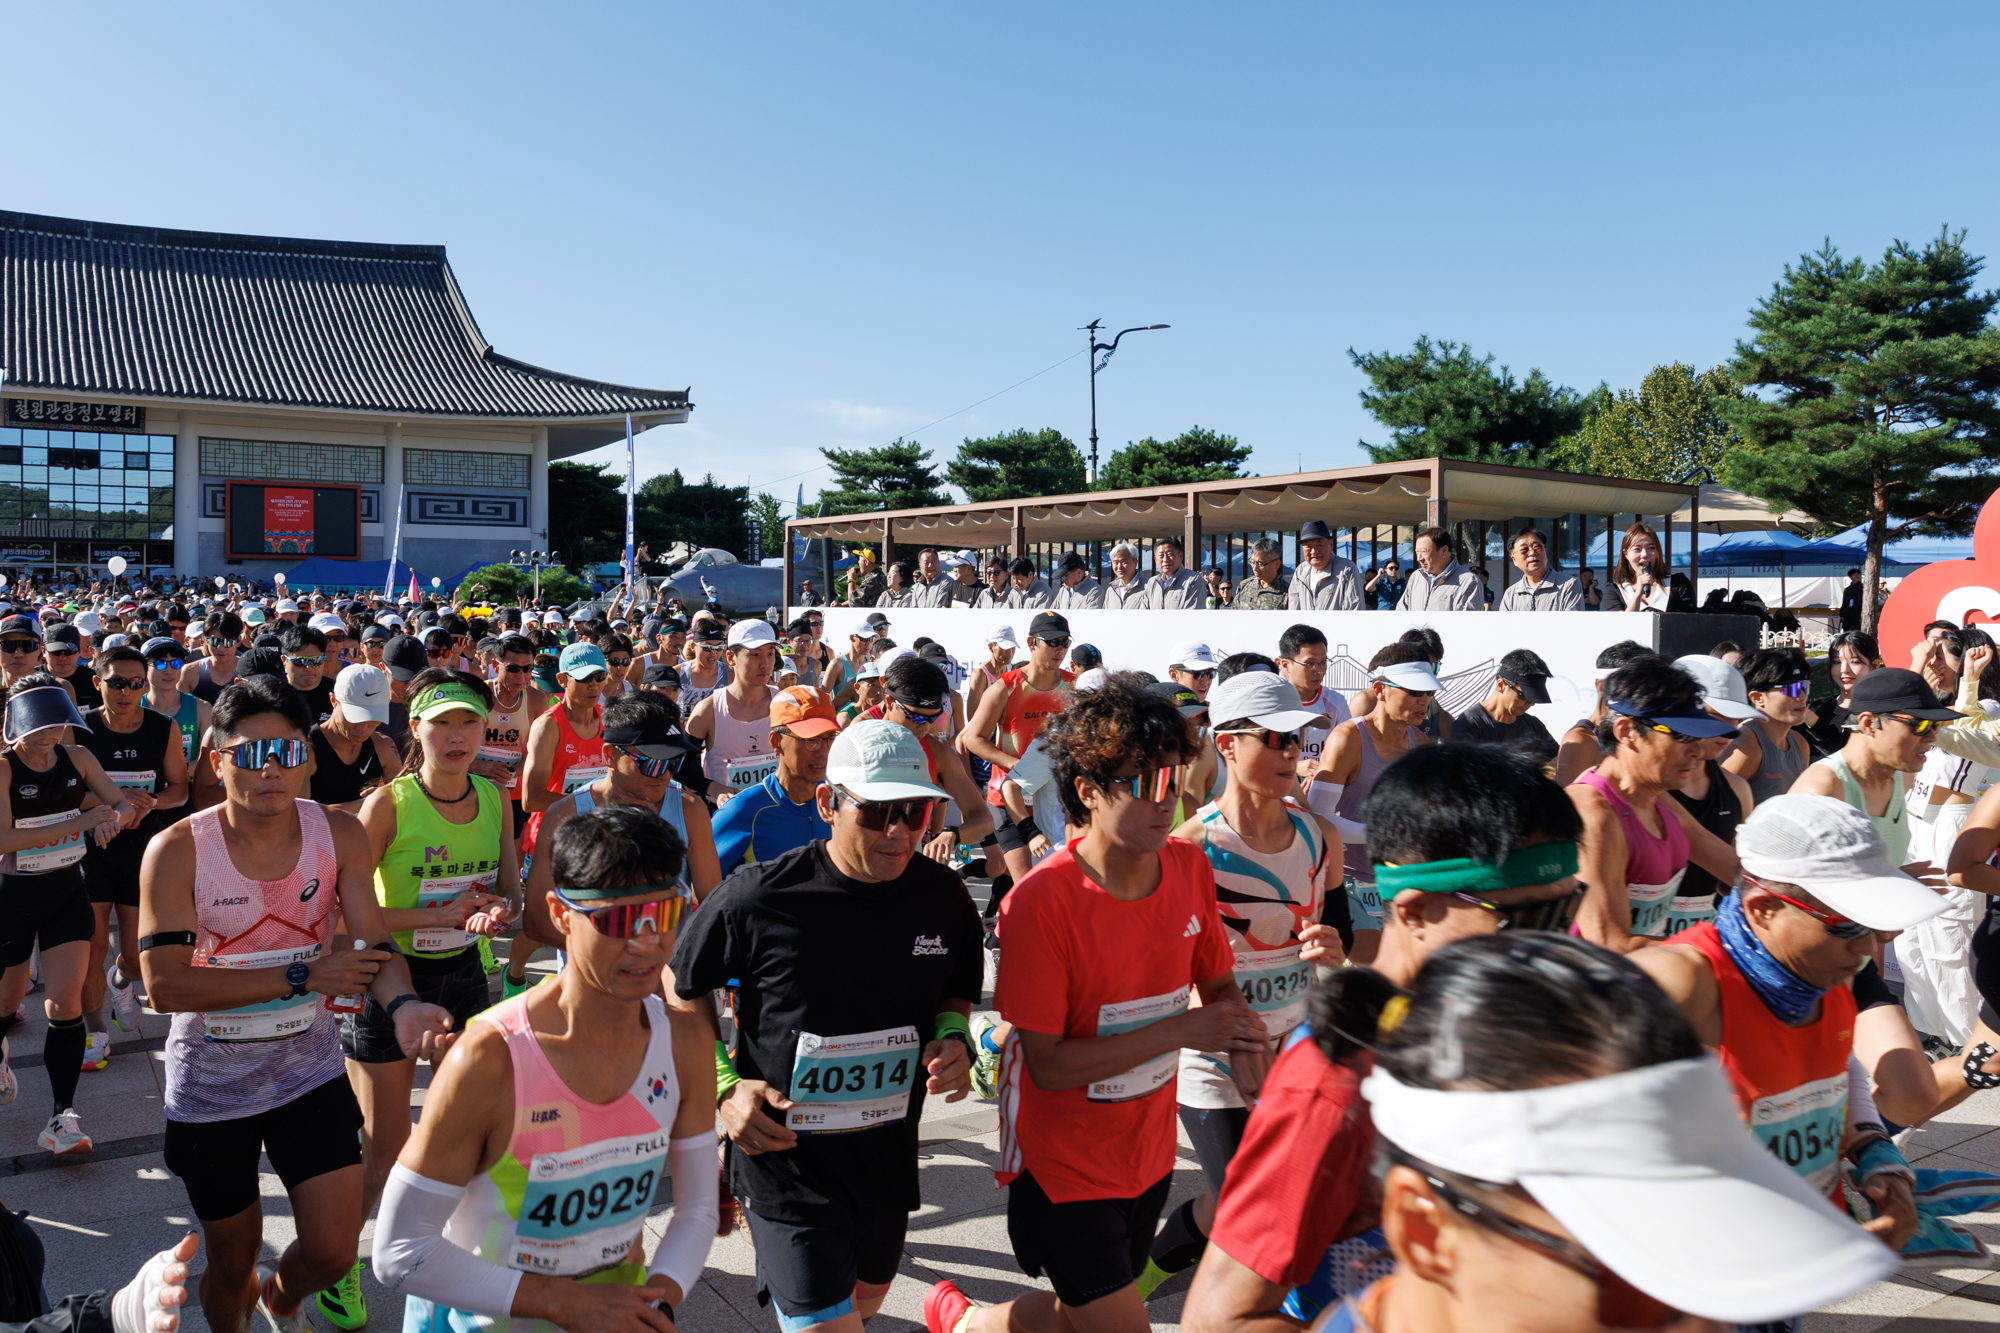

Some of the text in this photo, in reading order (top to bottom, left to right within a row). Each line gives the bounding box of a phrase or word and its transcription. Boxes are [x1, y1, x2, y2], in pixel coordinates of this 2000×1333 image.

[15, 400, 136, 425] 철원관광정보센터
[124, 749, 137, 758] T8
[480, 872, 497, 883] FULL
[212, 896, 249, 907] A-RACER
[293, 950, 319, 961] FULL
[1241, 967, 1309, 1004] 40325
[276, 1019, 302, 1032] 한국일보
[887, 1033, 918, 1046] FULL
[797, 1058, 908, 1094] 40314
[861, 1108, 890, 1121] 한국일보
[635, 1136, 667, 1155] FULL
[528, 1169, 654, 1228] 40929
